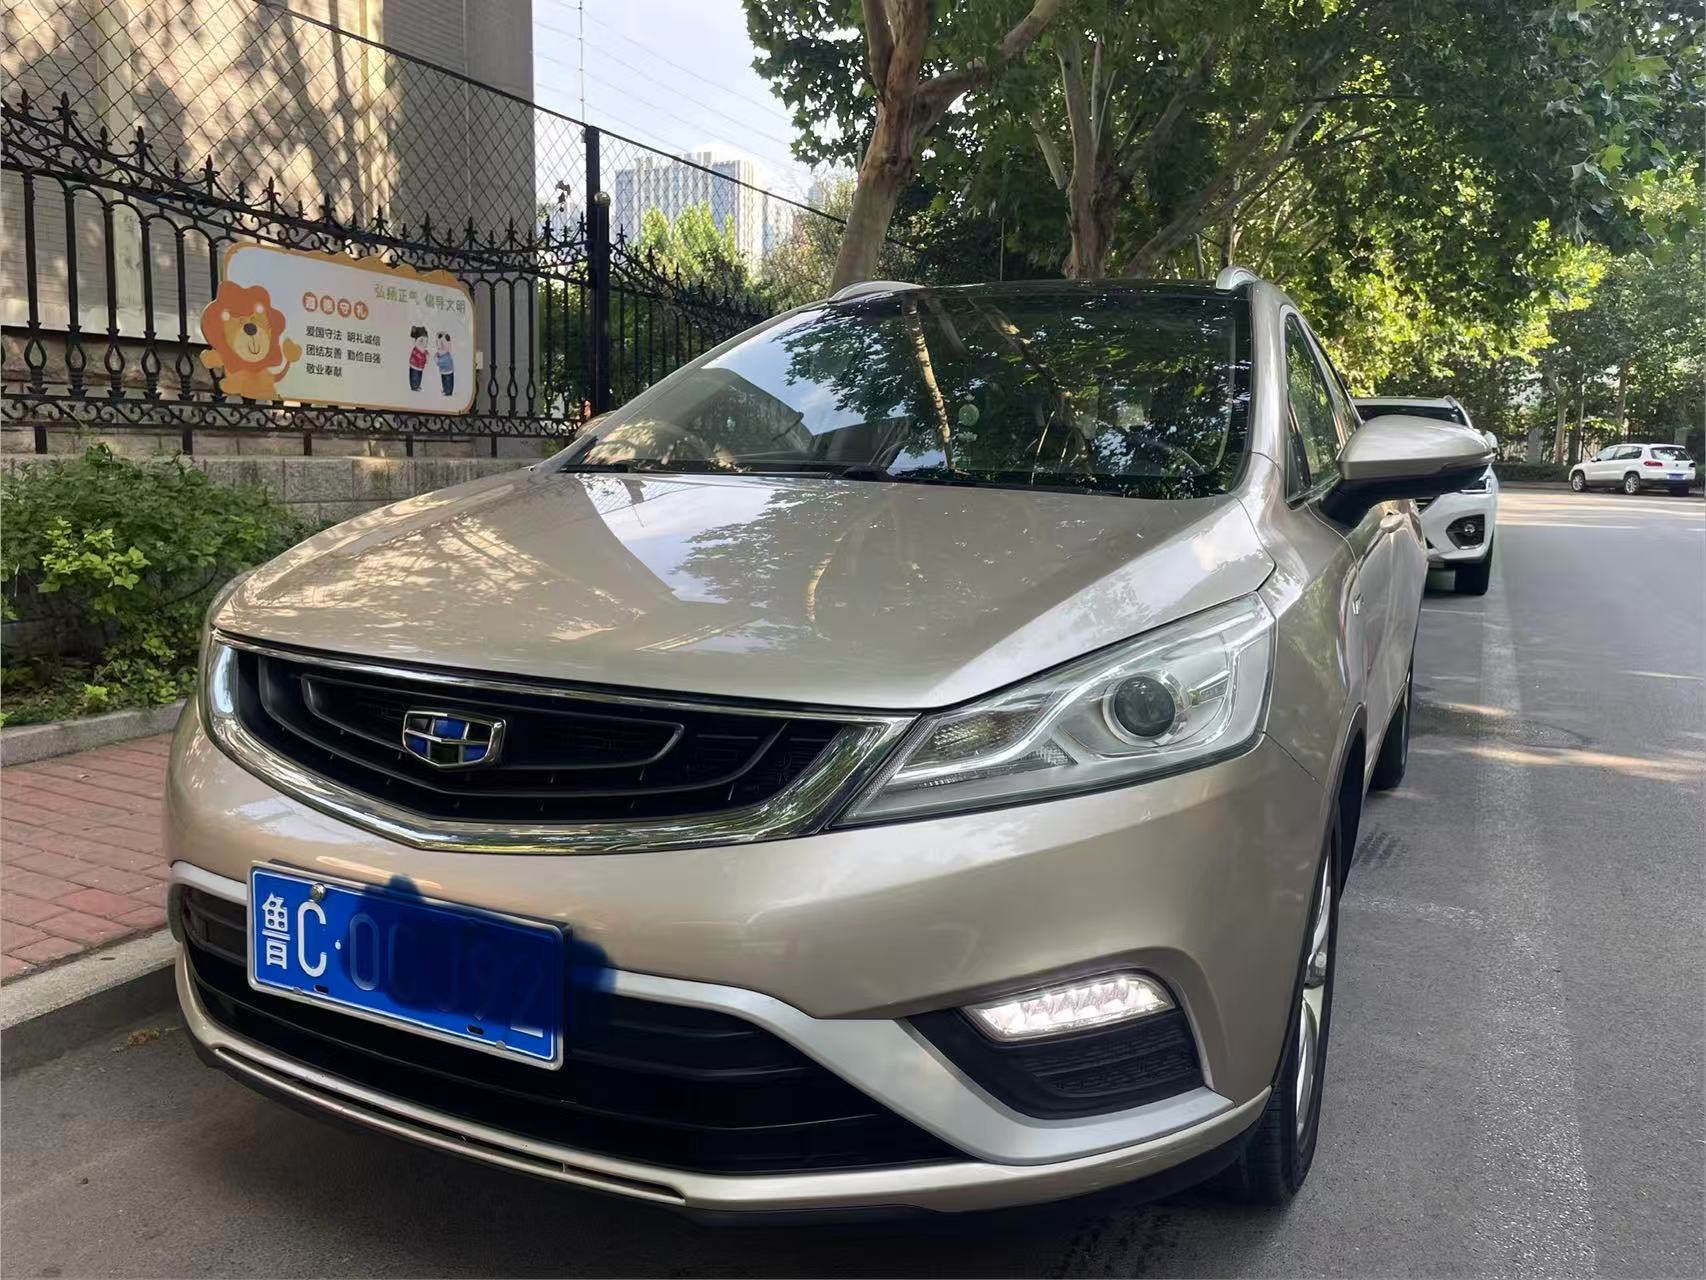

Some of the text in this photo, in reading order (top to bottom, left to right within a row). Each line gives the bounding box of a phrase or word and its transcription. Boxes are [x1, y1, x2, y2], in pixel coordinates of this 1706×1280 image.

[306, 325, 381, 346] 爱国守法 明礼诚信
[306, 343, 381, 364] 团结友善 勤俭自强
[306, 363, 342, 377] 敬业奉献
